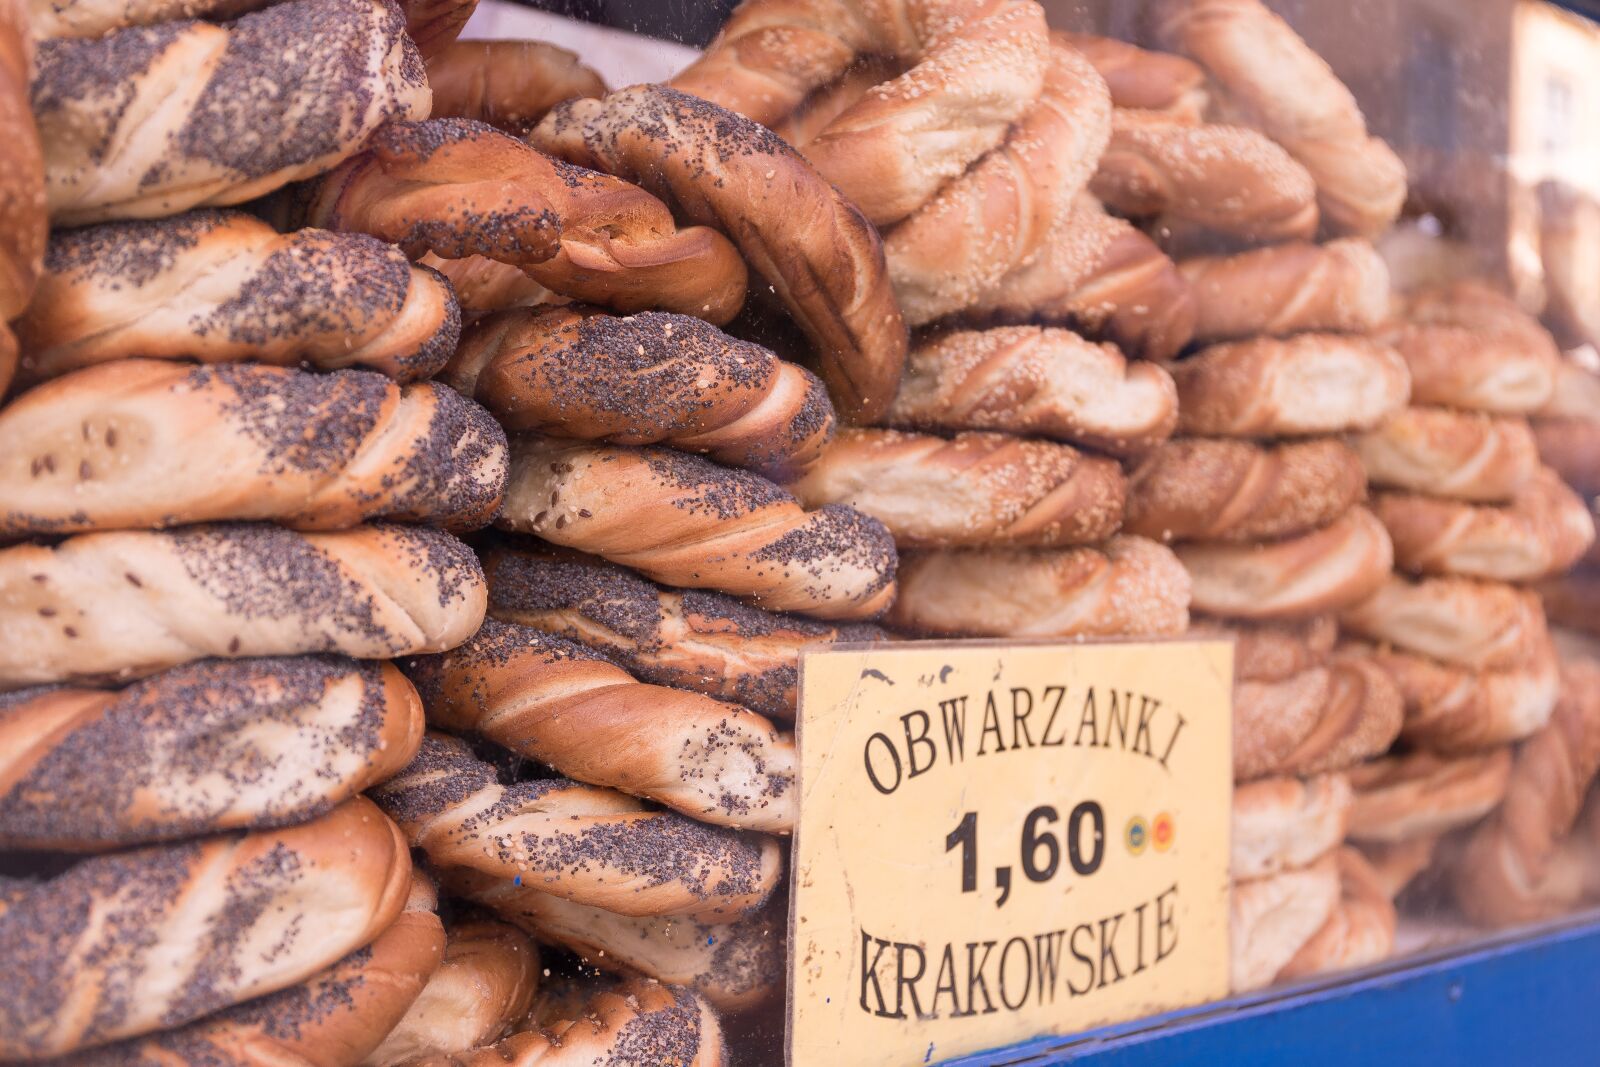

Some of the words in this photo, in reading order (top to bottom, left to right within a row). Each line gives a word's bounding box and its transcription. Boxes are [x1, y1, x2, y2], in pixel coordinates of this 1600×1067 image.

[864, 686, 1188, 794] OBWARZANKI
[945, 800, 1106, 908] 1,60
[860, 884, 1179, 1020] KRAKOWSKIE
